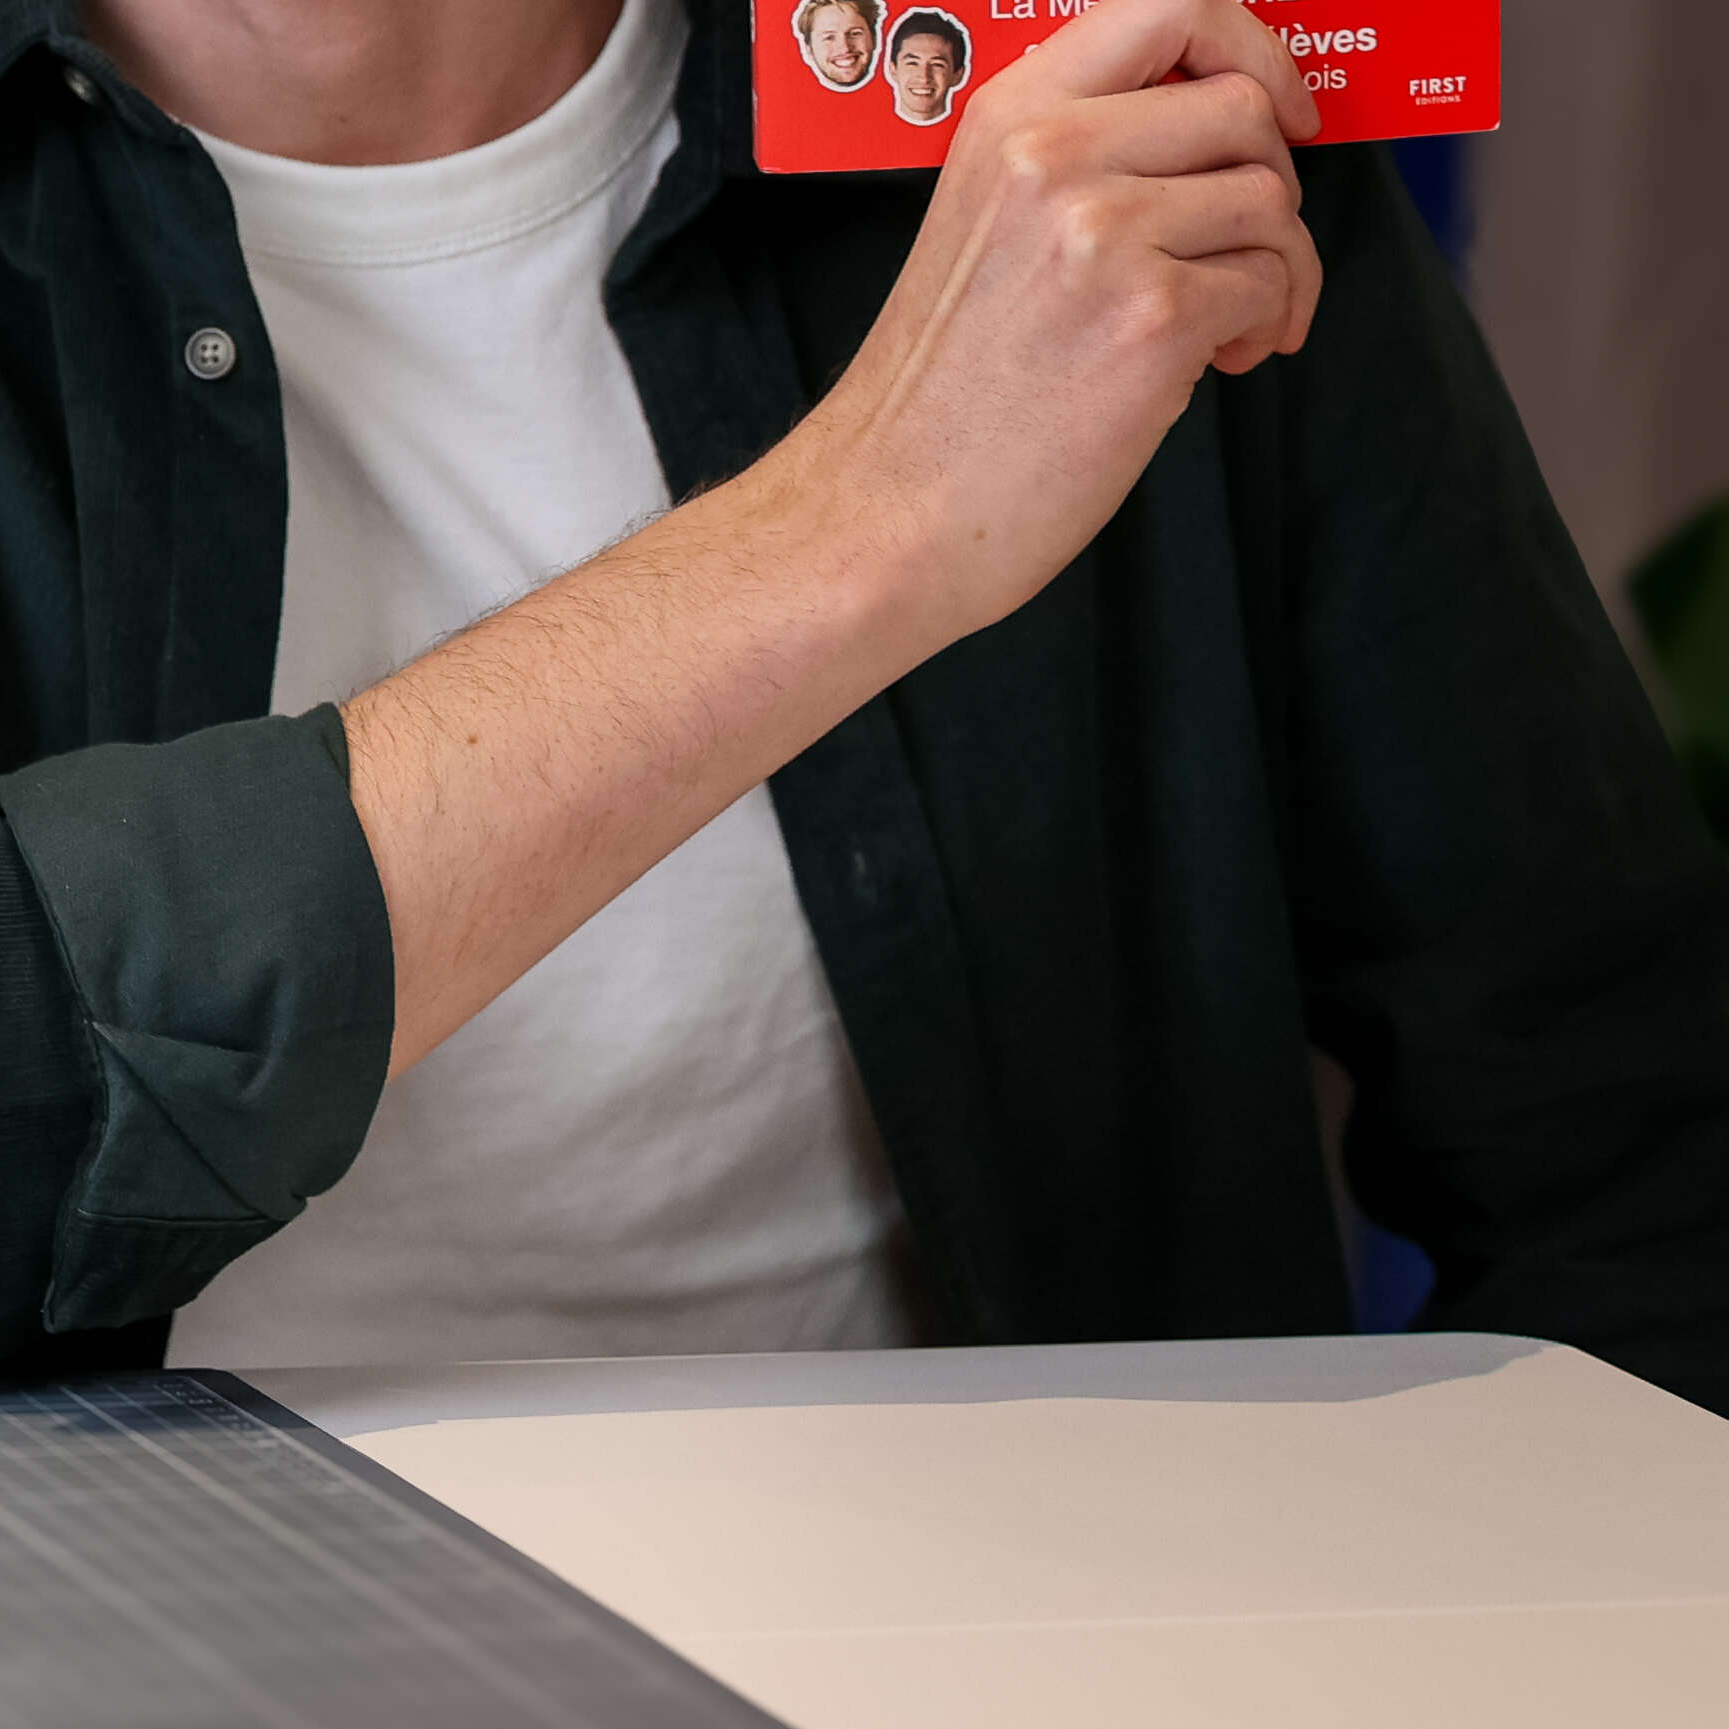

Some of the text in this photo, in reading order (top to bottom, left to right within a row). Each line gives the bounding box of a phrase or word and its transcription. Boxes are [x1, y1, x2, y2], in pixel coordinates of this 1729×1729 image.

[1267, 24, 1377, 57] lèves
[1306, 65, 1347, 92] ois
[1409, 76, 1466, 96] FIRST
